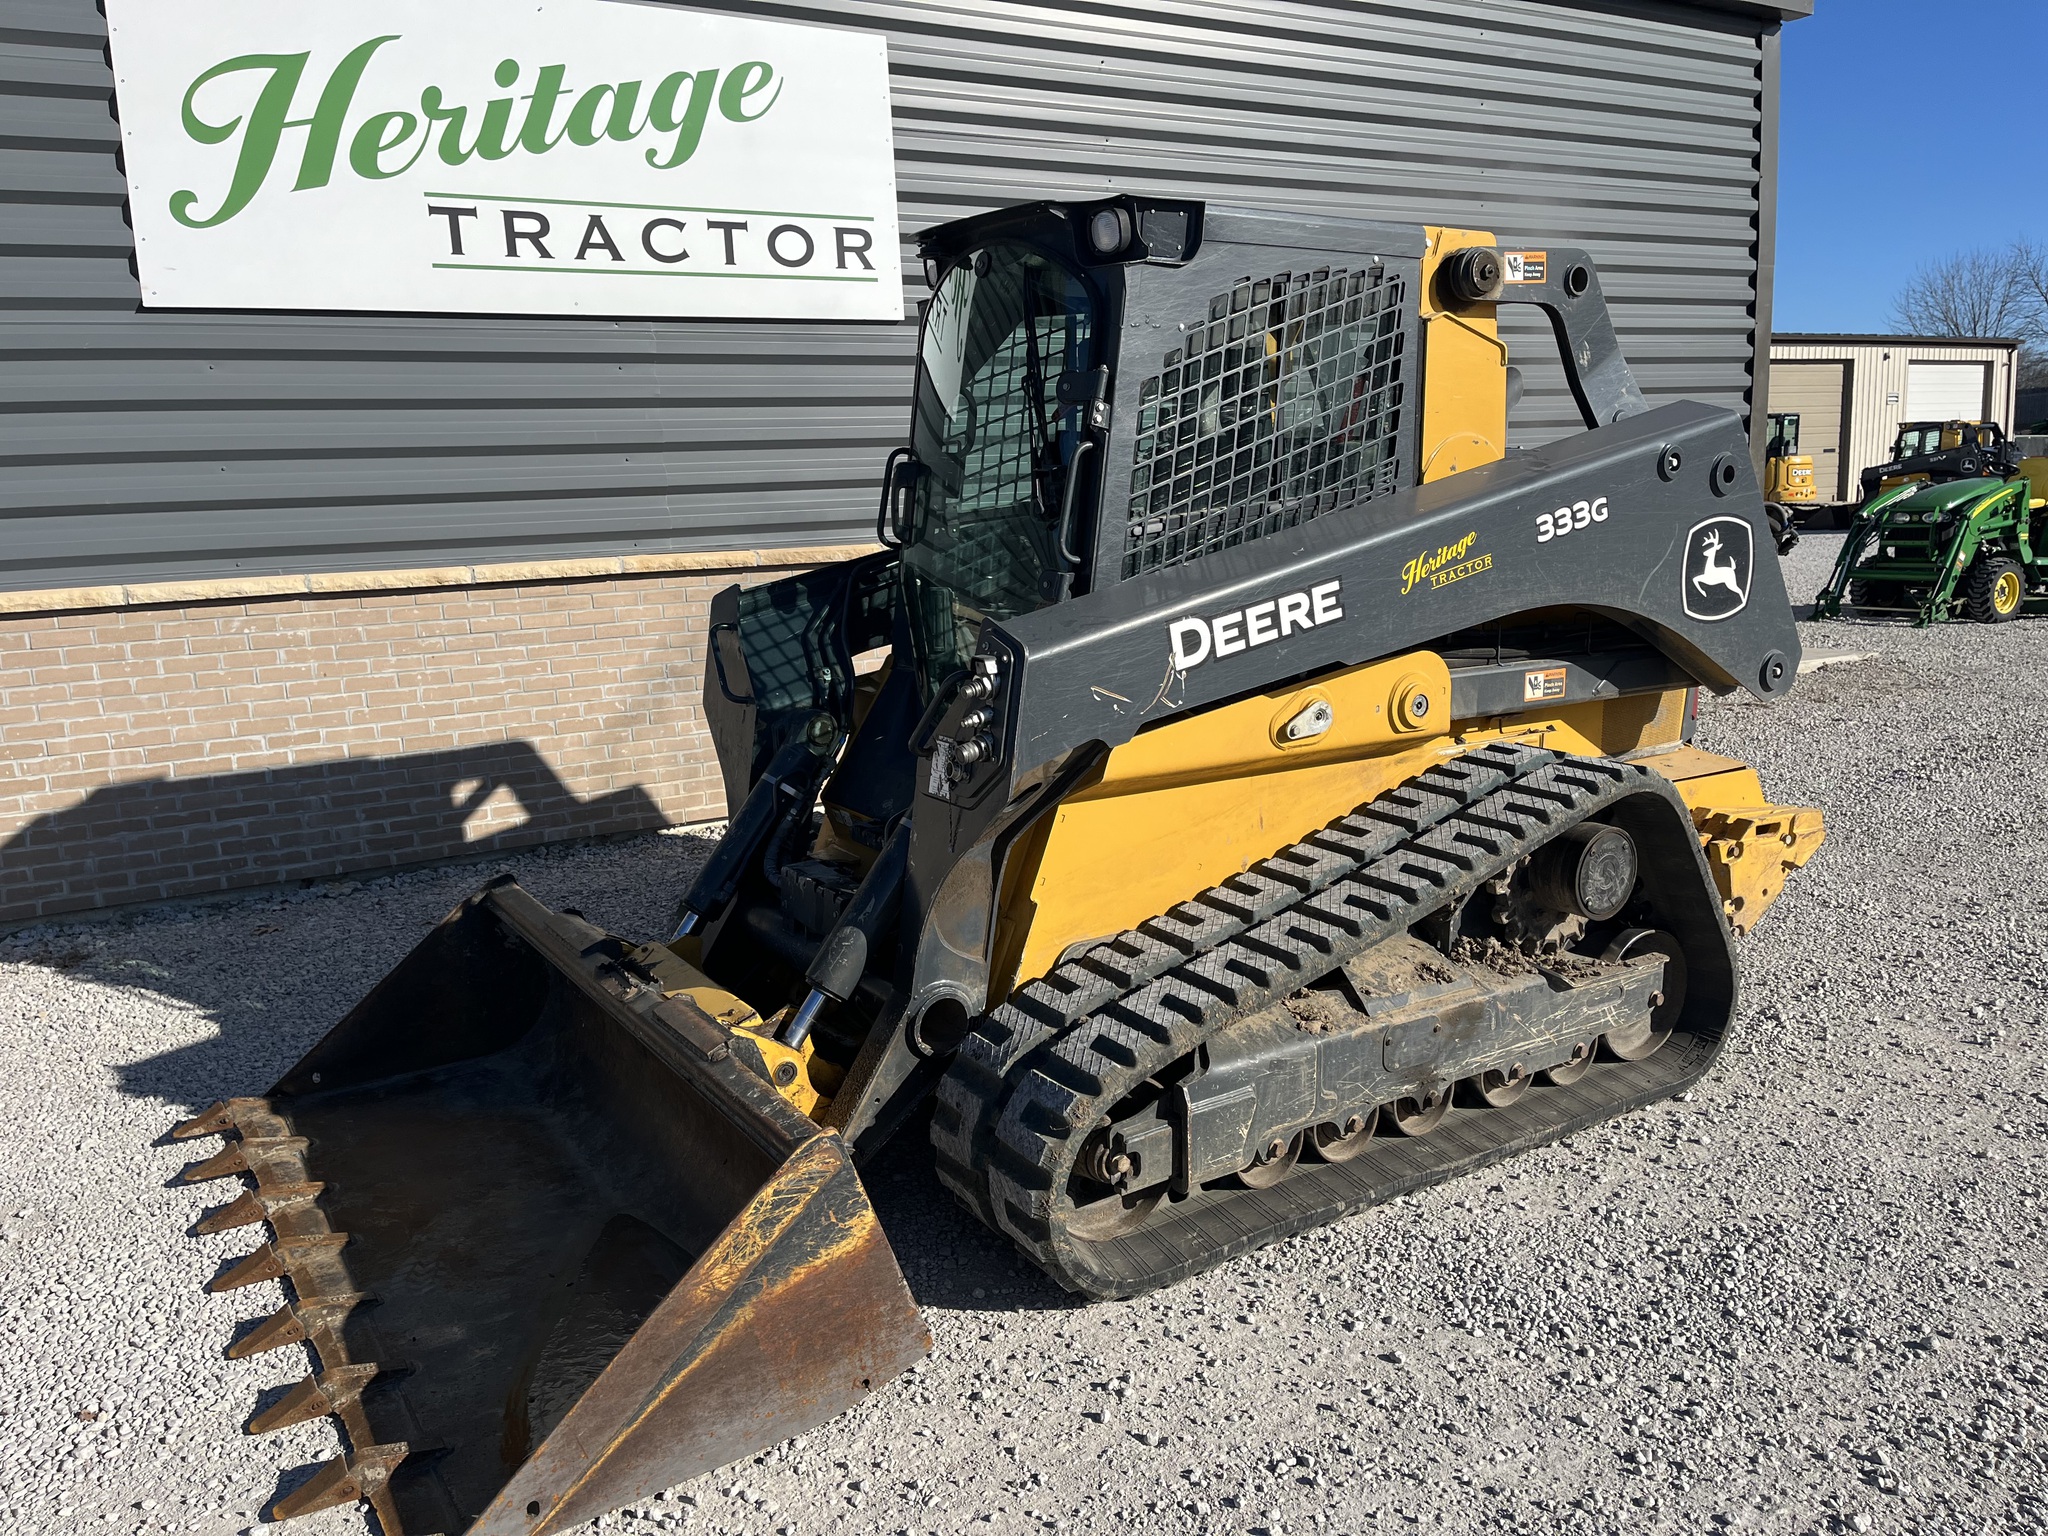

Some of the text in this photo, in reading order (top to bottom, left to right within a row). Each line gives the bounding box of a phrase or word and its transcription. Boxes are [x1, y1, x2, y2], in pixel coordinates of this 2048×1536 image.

[168, 35, 783, 228] Heritage
[427, 202, 877, 271] TRACTOR
[1879, 463, 1902, 473] DEERE
[1535, 496, 1609, 543] 333G
[1401, 531, 1477, 595] Heritage
[1430, 556, 1493, 587] TRACTOR
[1169, 580, 1343, 671] DEERE
